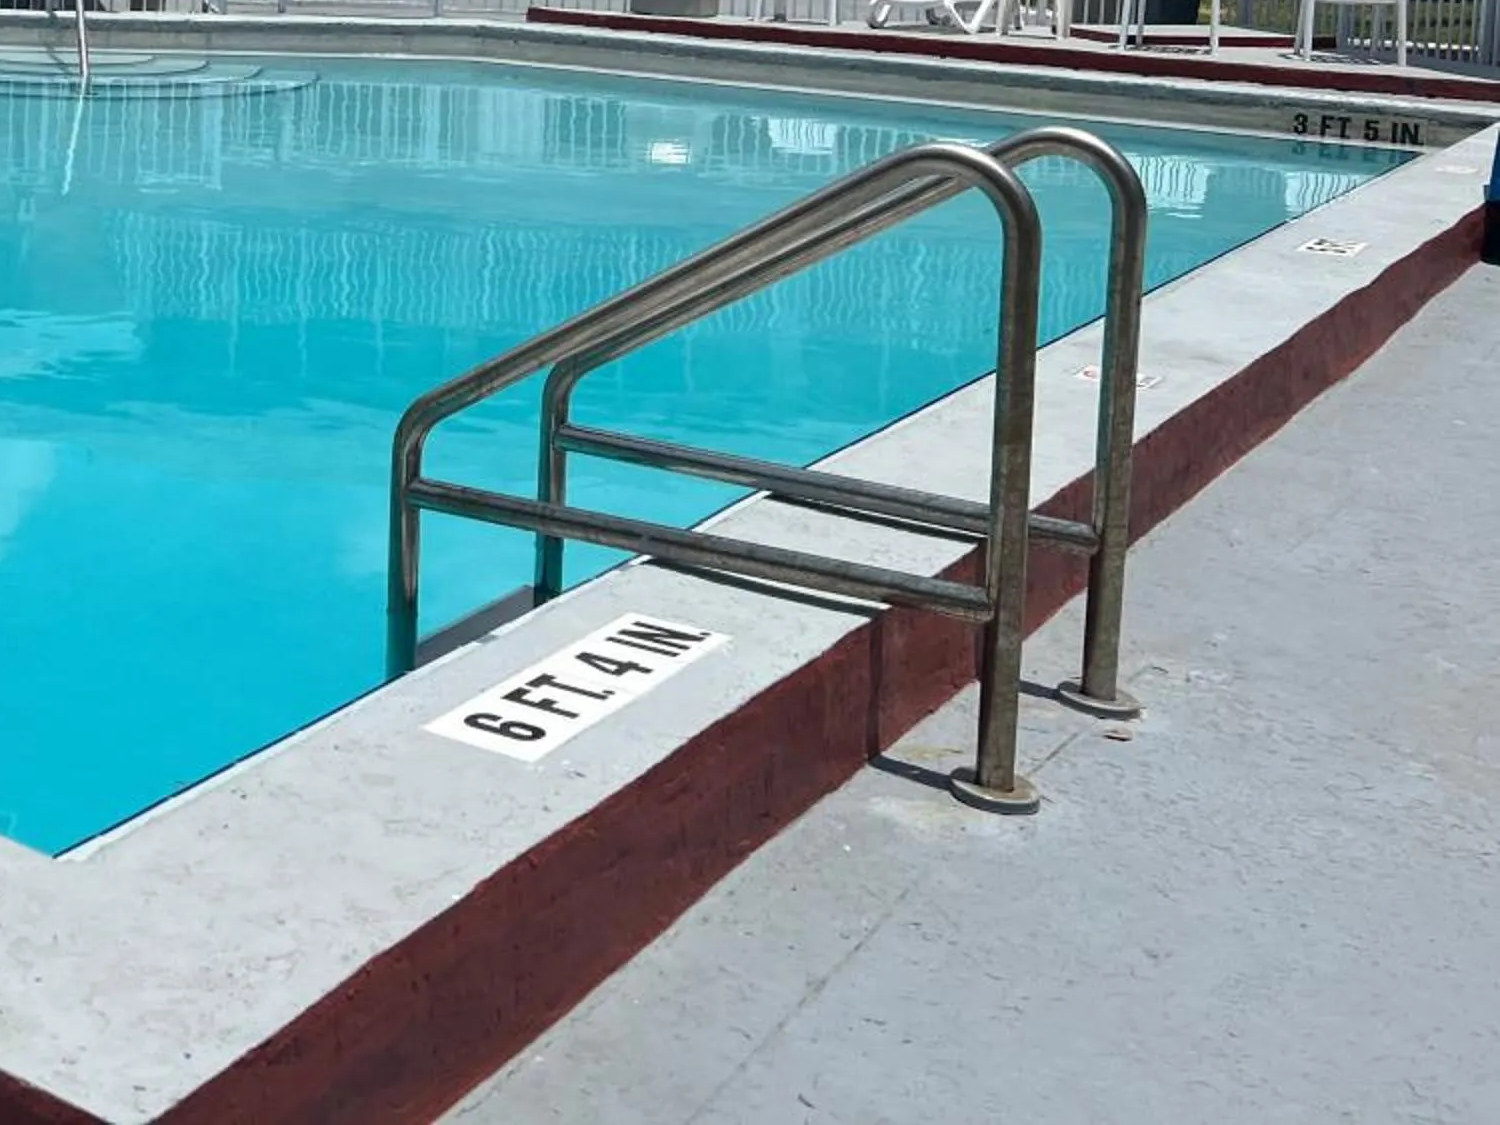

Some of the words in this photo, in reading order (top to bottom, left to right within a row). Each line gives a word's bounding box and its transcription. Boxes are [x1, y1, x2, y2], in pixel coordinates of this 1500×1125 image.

[1293, 112, 1309, 135] 3
[1363, 118, 1381, 141] 5
[462, 711, 548, 742] 6
[574, 652, 654, 677] 4
